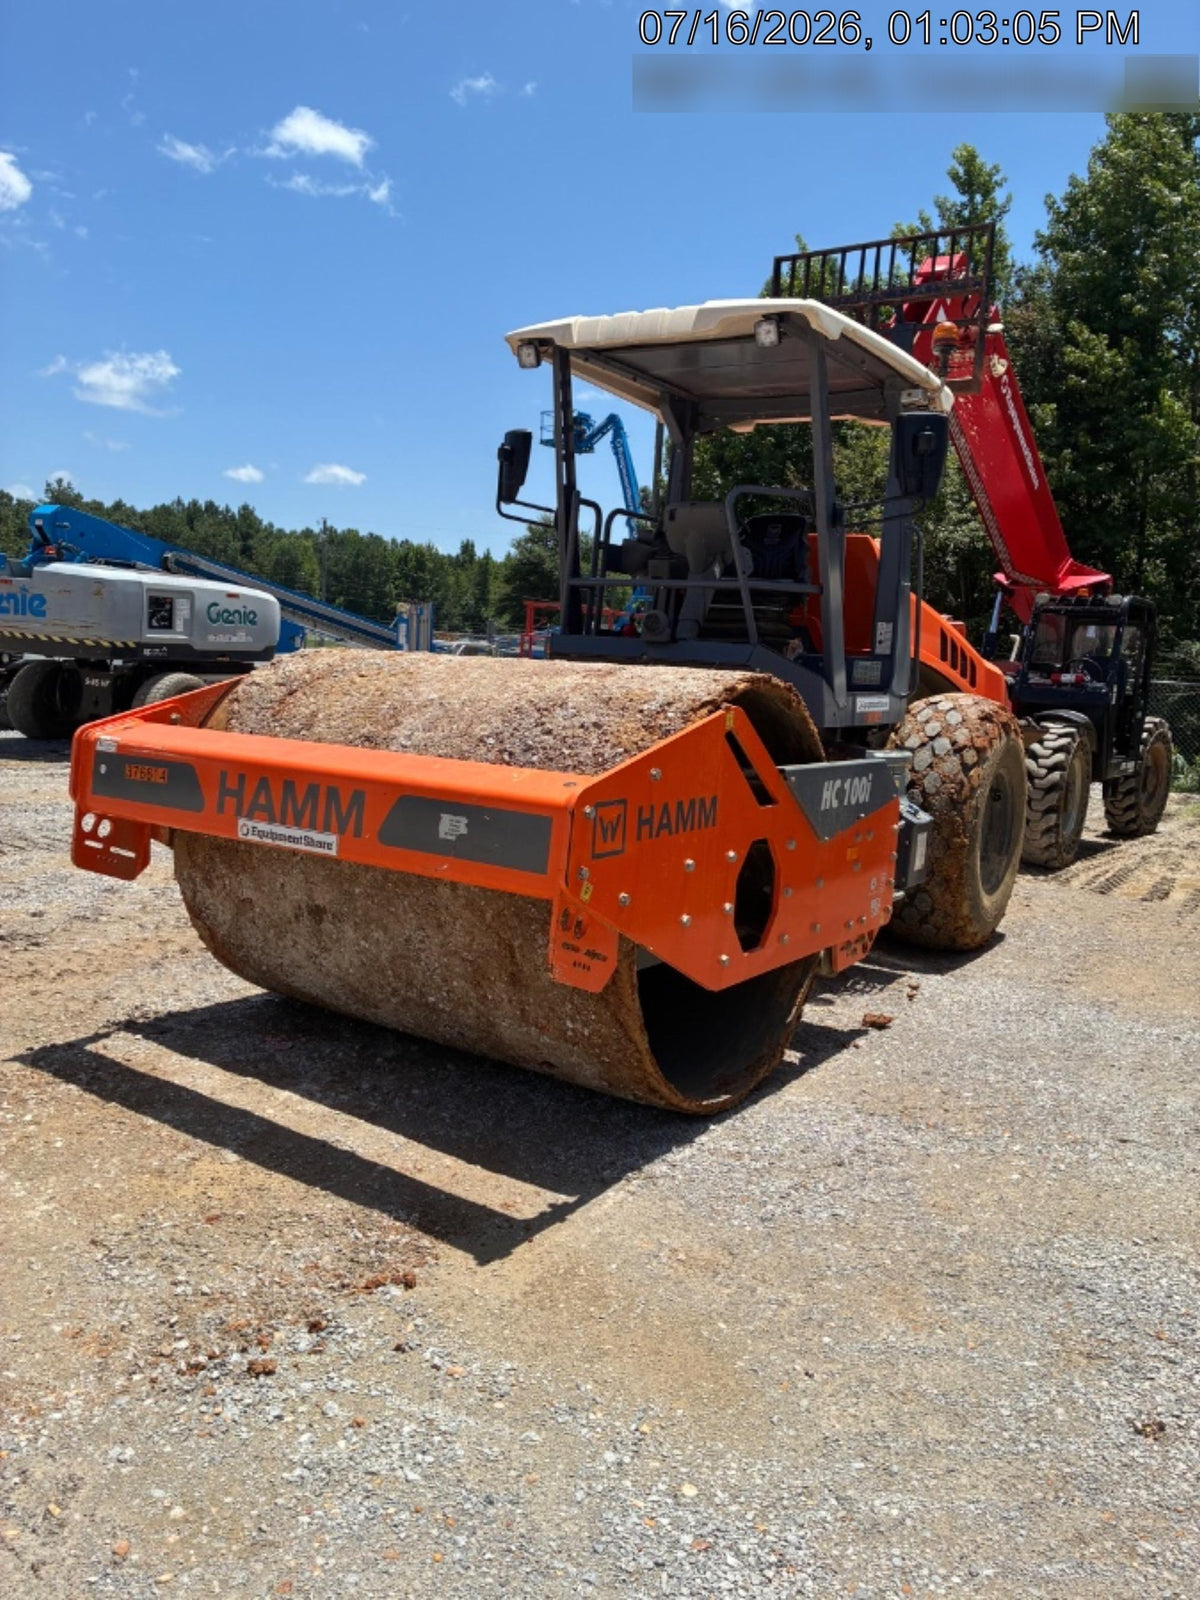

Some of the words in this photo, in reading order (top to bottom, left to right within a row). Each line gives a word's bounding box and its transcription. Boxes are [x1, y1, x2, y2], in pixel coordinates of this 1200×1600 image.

[206, 602, 257, 626] Genie
[216, 770, 366, 839] HAMM
[820, 778, 842, 811] HC
[843, 772, 873, 806] 100i
[251, 825, 335, 851] EquipmentShare
[636, 795, 718, 842] HAMM
